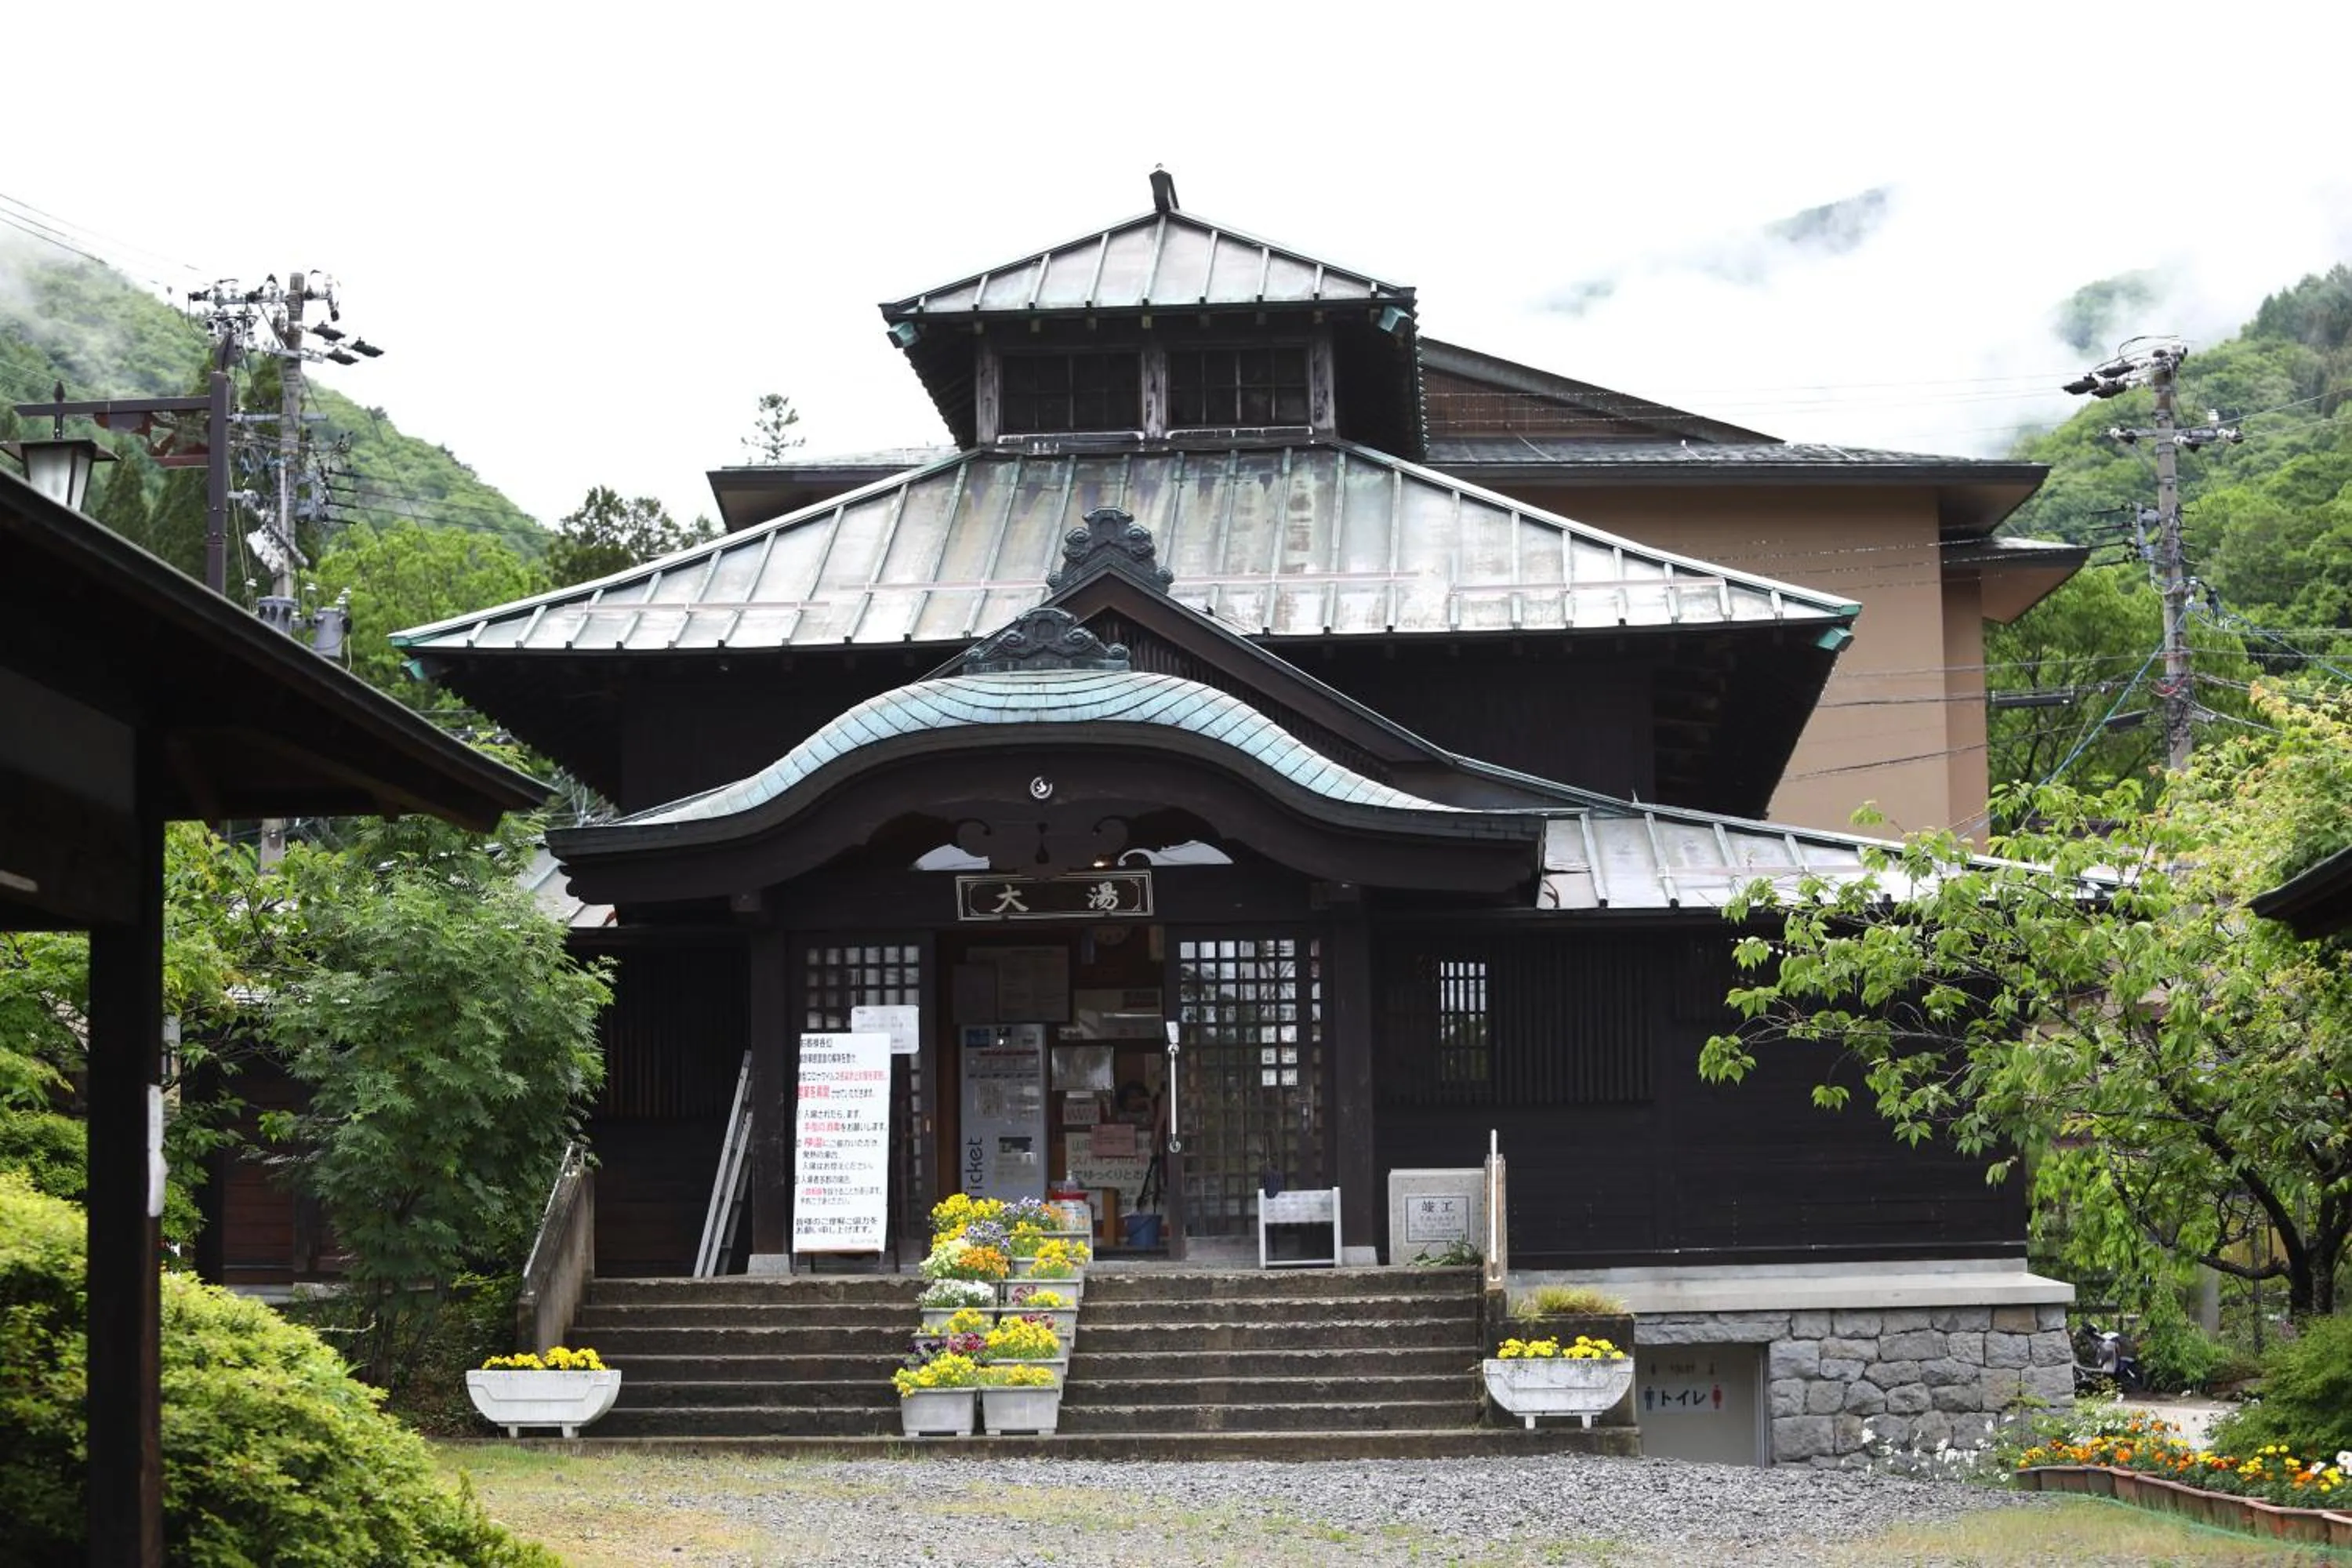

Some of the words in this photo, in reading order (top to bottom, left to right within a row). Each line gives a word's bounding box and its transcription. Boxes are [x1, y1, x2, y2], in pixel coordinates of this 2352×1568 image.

[991, 881, 1120, 913] 大湯
[1661, 1389, 1707, 1406] トイレ
